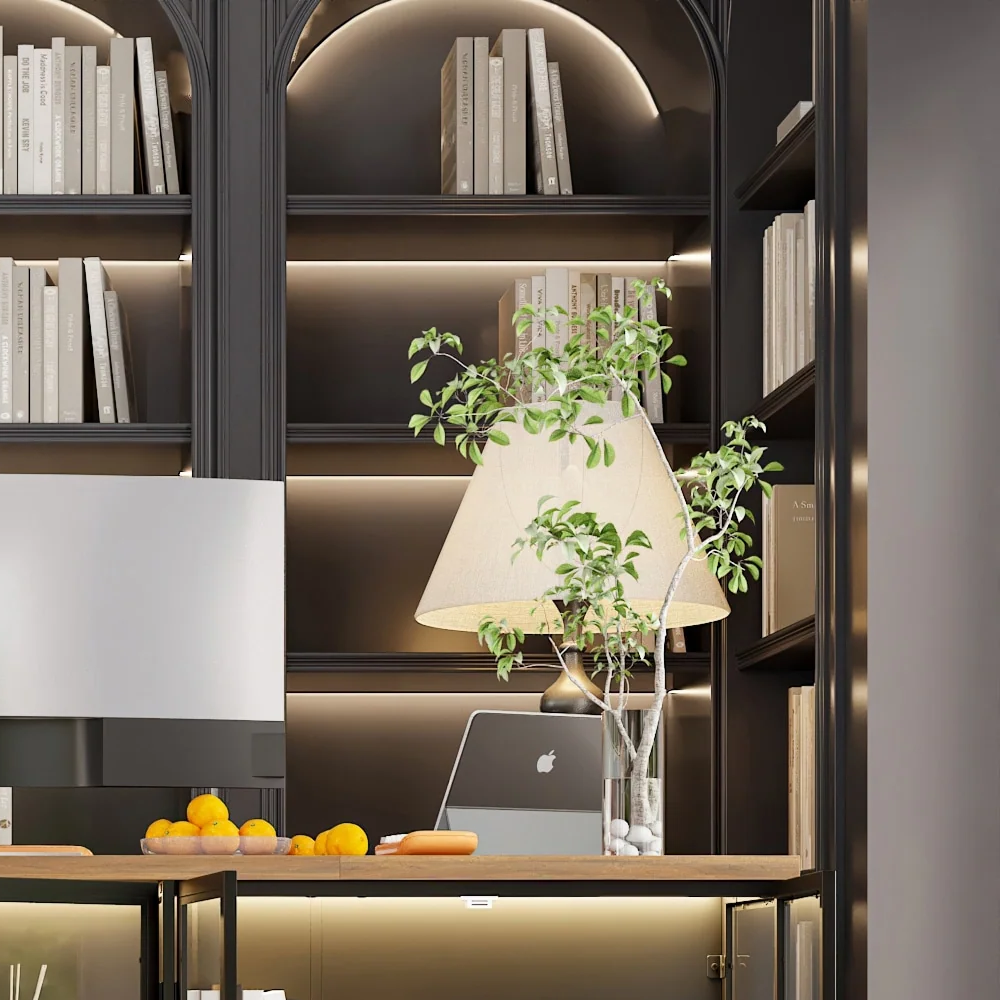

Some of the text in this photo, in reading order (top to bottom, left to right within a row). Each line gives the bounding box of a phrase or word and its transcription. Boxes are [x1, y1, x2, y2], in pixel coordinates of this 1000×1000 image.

[21, 67, 30, 80] THE
[21, 81, 30, 94] JOB
[39, 90, 48, 107] Good
[21, 119, 30, 138] KEVIN
[793, 500, 799, 509] A
